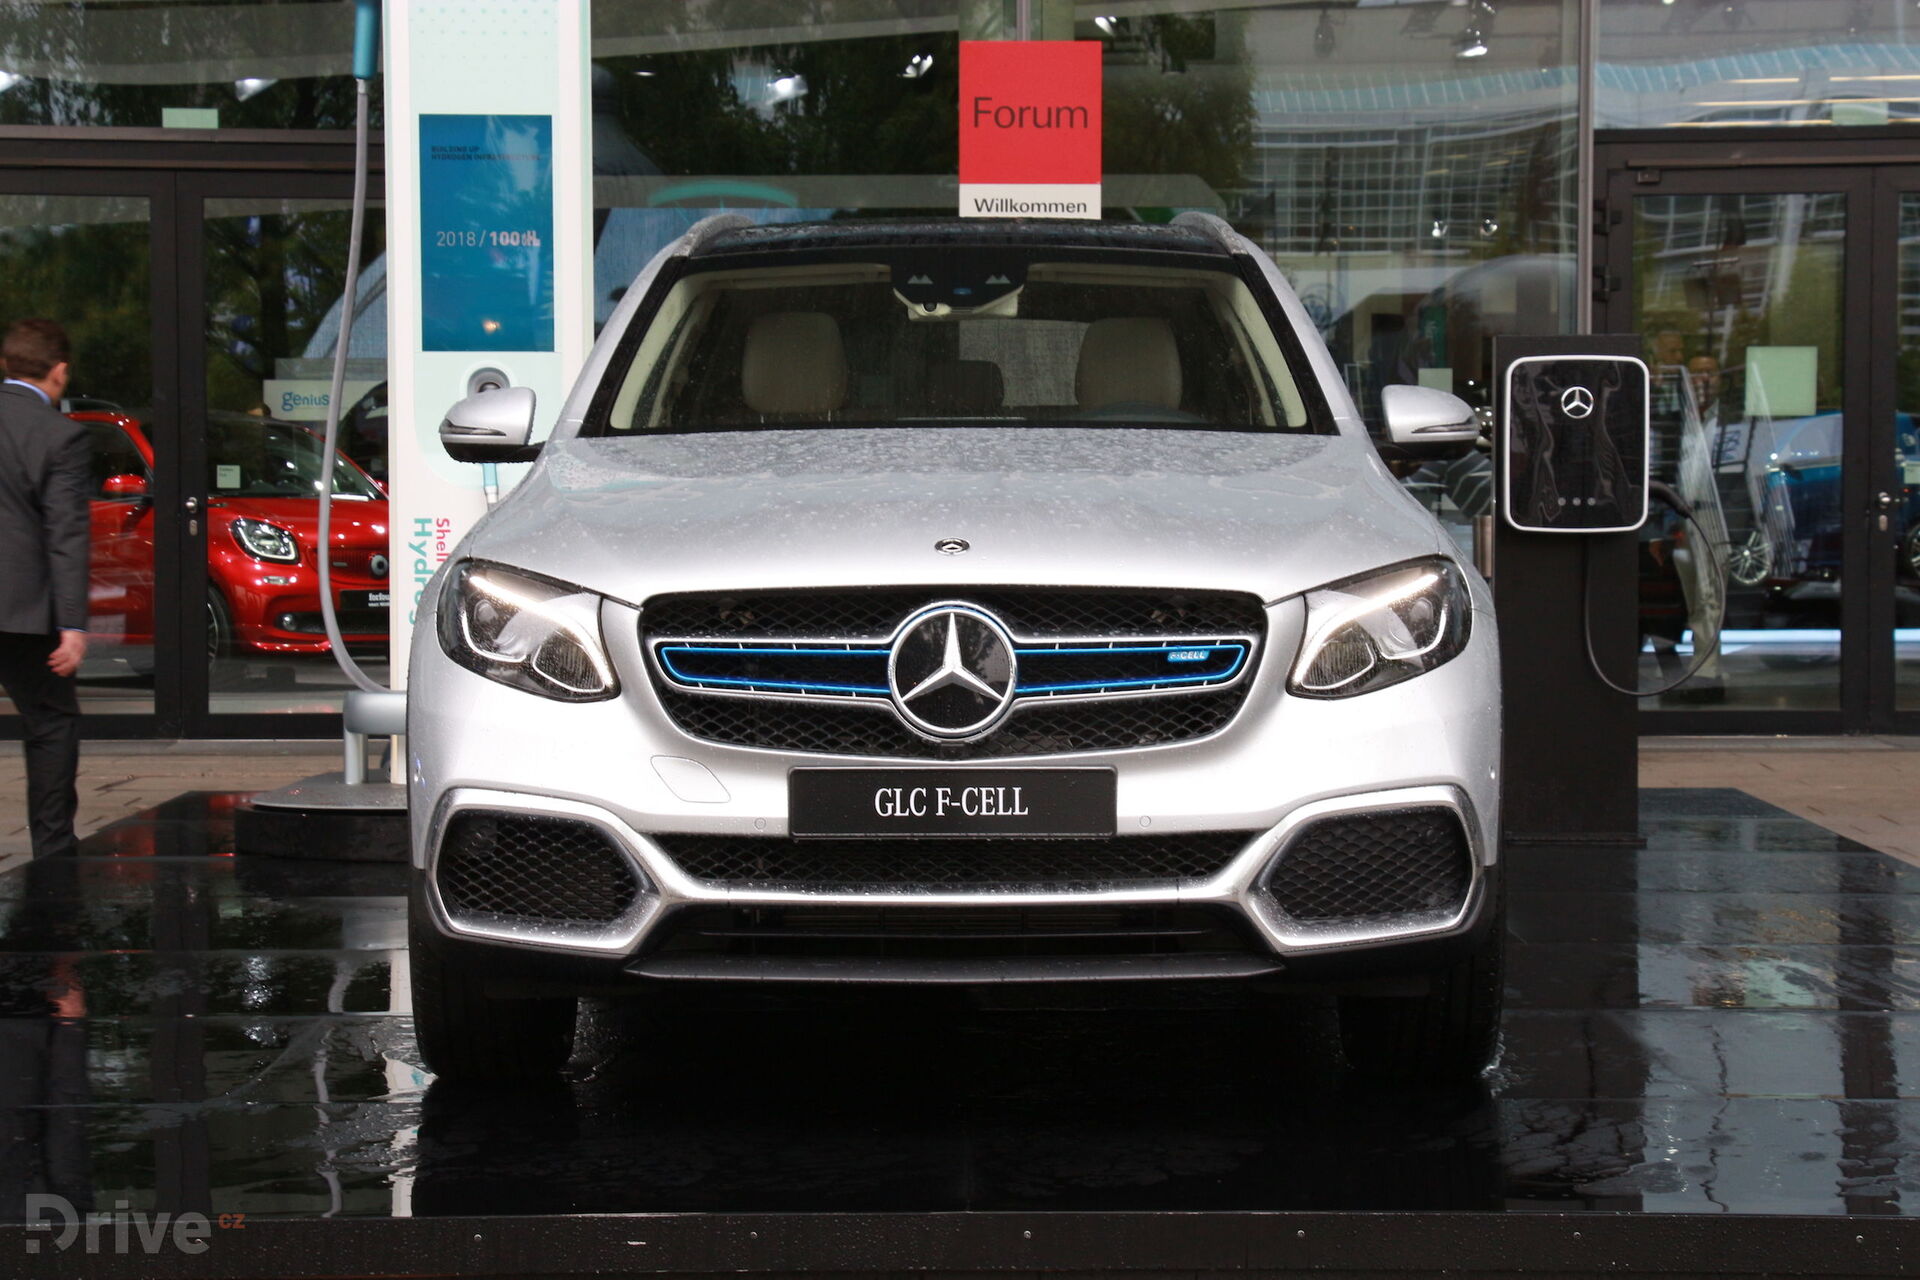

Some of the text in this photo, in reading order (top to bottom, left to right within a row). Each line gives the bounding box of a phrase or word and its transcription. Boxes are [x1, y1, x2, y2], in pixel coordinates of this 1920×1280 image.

[974, 96, 1088, 128] Forum
[974, 198, 1087, 213] Willkommen
[874, 787, 1029, 817] GLC F-CELL
